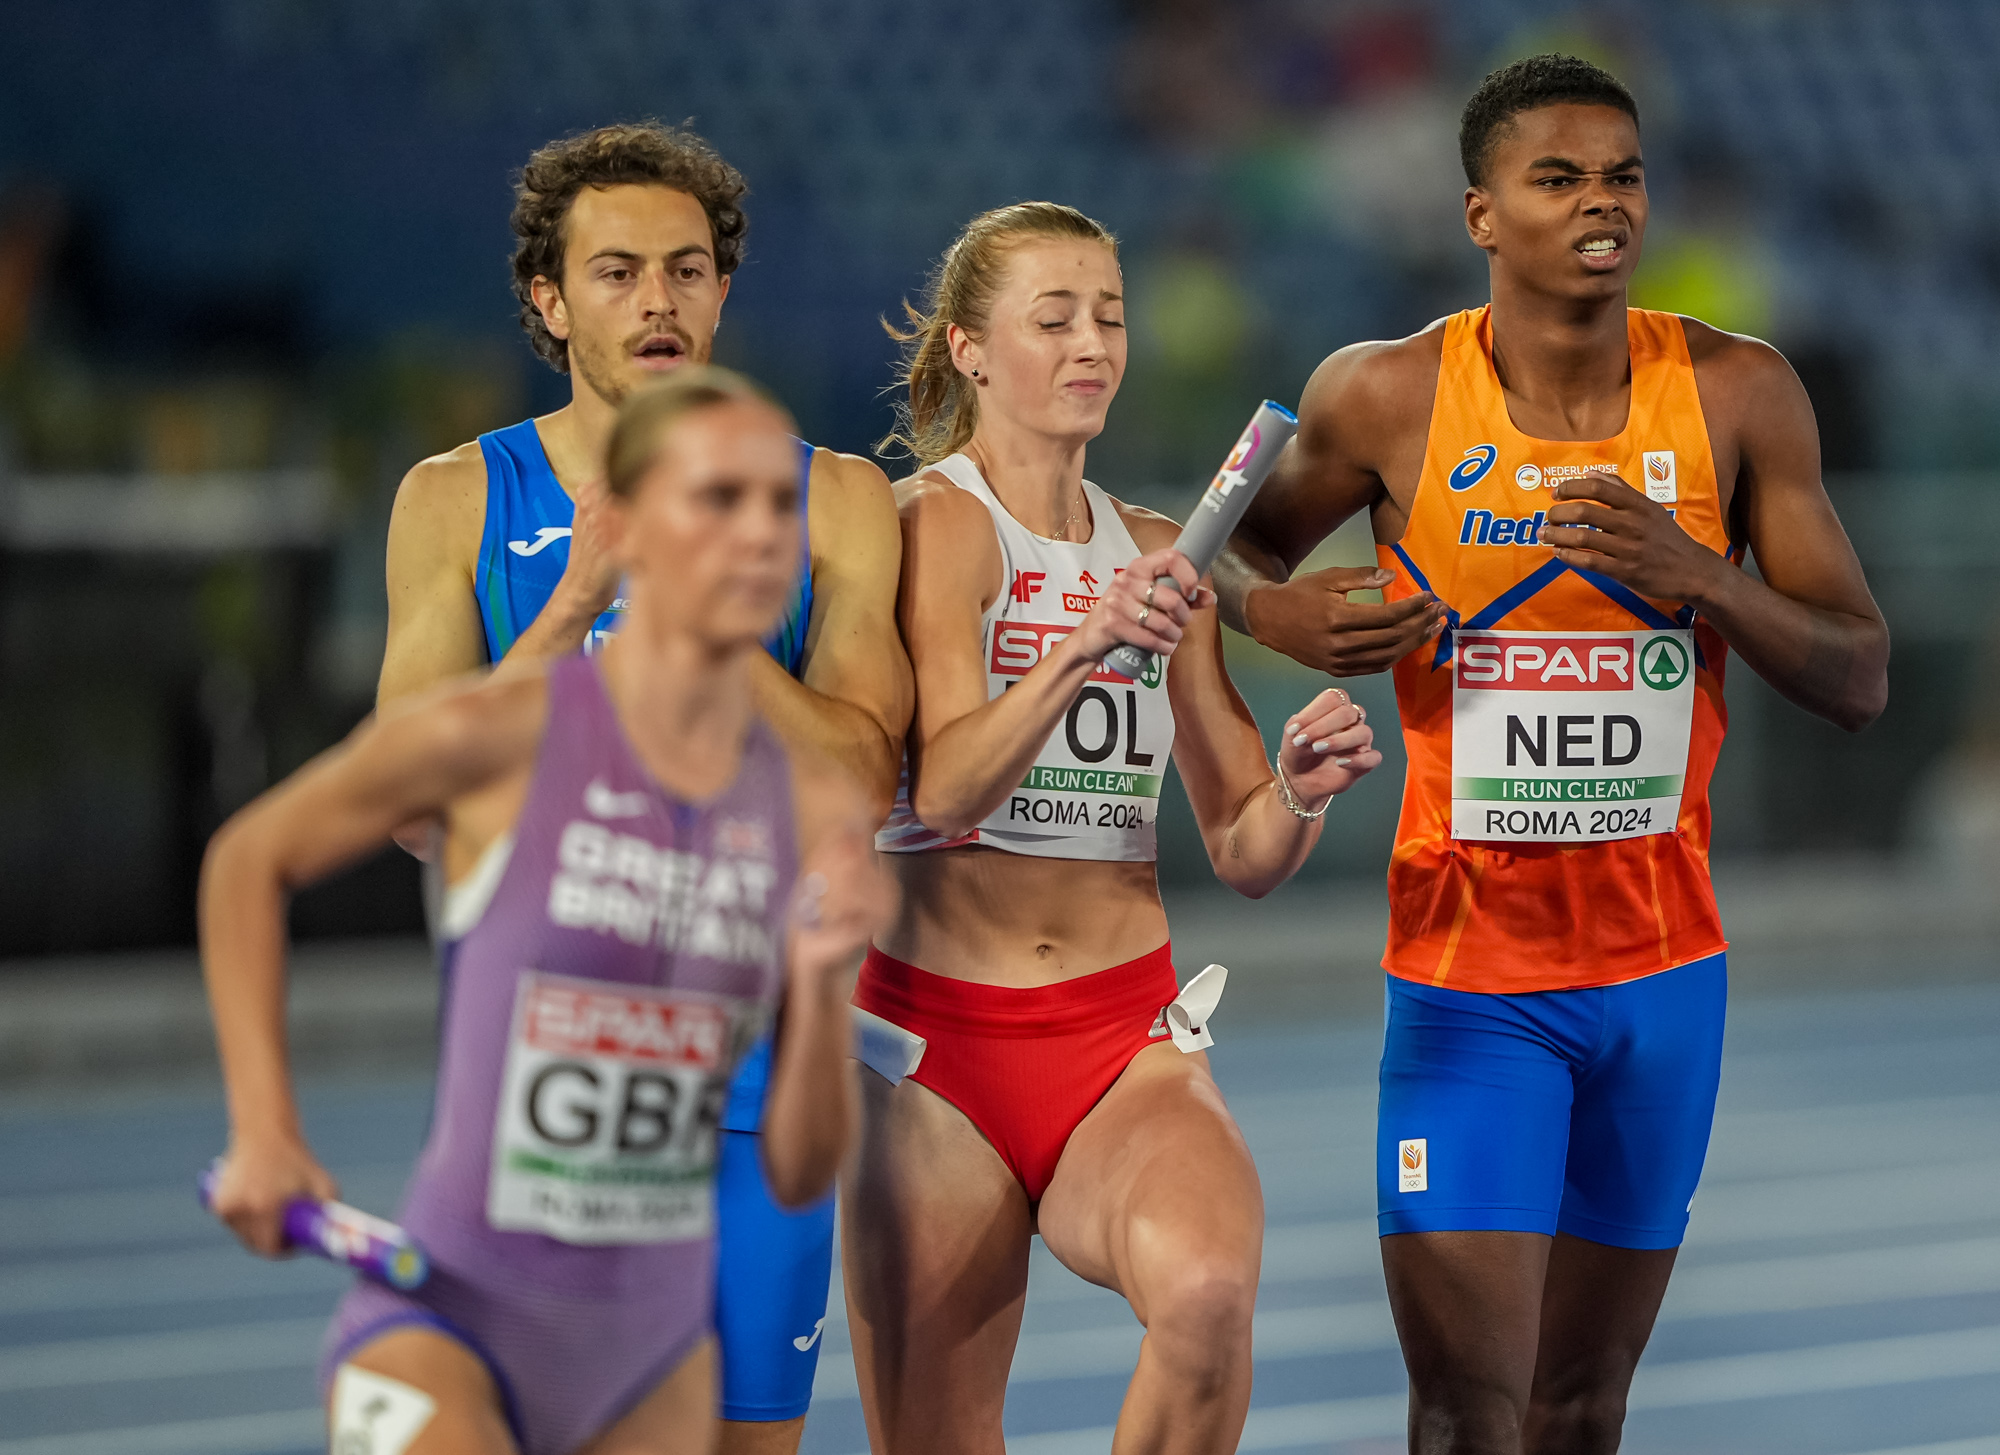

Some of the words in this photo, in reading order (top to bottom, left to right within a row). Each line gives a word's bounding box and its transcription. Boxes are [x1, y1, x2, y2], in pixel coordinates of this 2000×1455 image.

[1543, 464, 1619, 476] NEDERLANDSE
[1066, 596, 1100, 611] ORLE
[1462, 644, 1630, 683] SPAR
[1006, 681, 1155, 767] OL
[1506, 715, 1642, 767] NED
[1030, 769, 1035, 786] I
[1041, 769, 1081, 789] RUN
[1502, 781, 1508, 798] I
[1513, 781, 1562, 799] RUN
[1010, 796, 1091, 826] ROMA
[1097, 802, 1144, 830] 2024
[1486, 810, 1582, 835] ROMA
[1590, 807, 1652, 834] 2024
